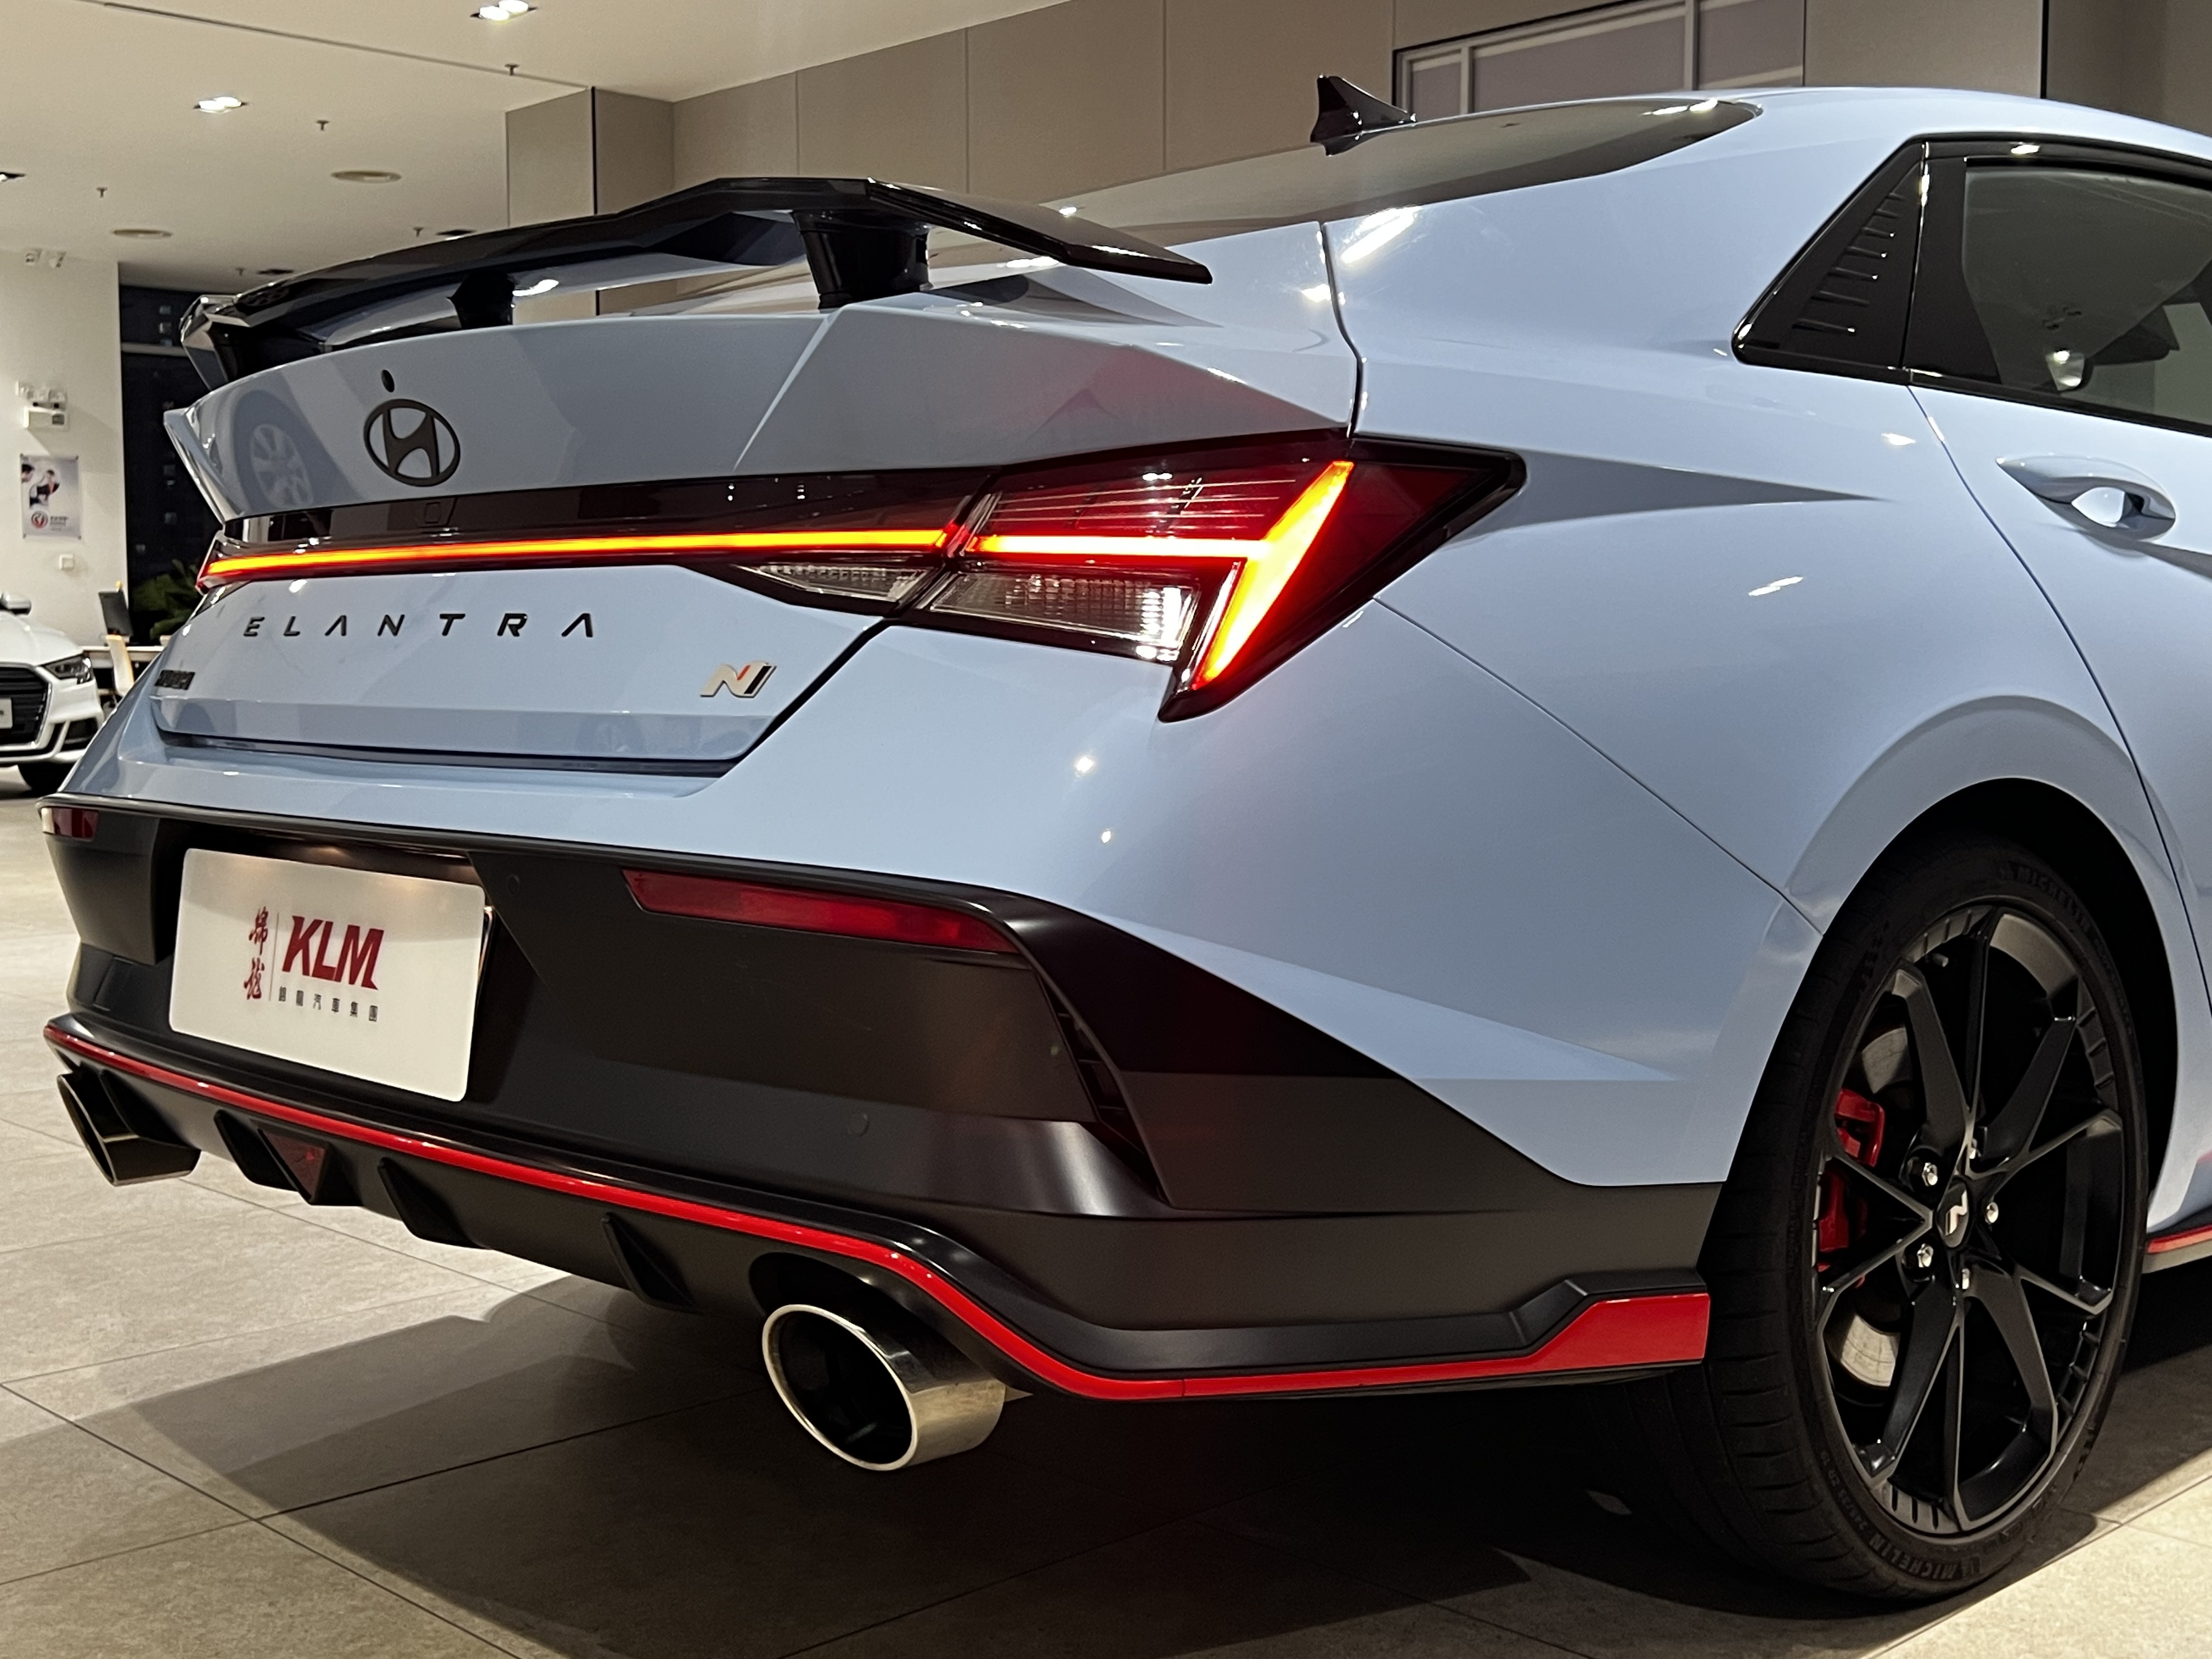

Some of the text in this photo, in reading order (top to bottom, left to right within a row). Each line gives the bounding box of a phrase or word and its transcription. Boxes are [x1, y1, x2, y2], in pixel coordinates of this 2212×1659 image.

[242, 613, 593, 638] ELANTRA
[281, 915, 385, 991] KLM
[1867, 1533, 1957, 1580] MICHELIN
